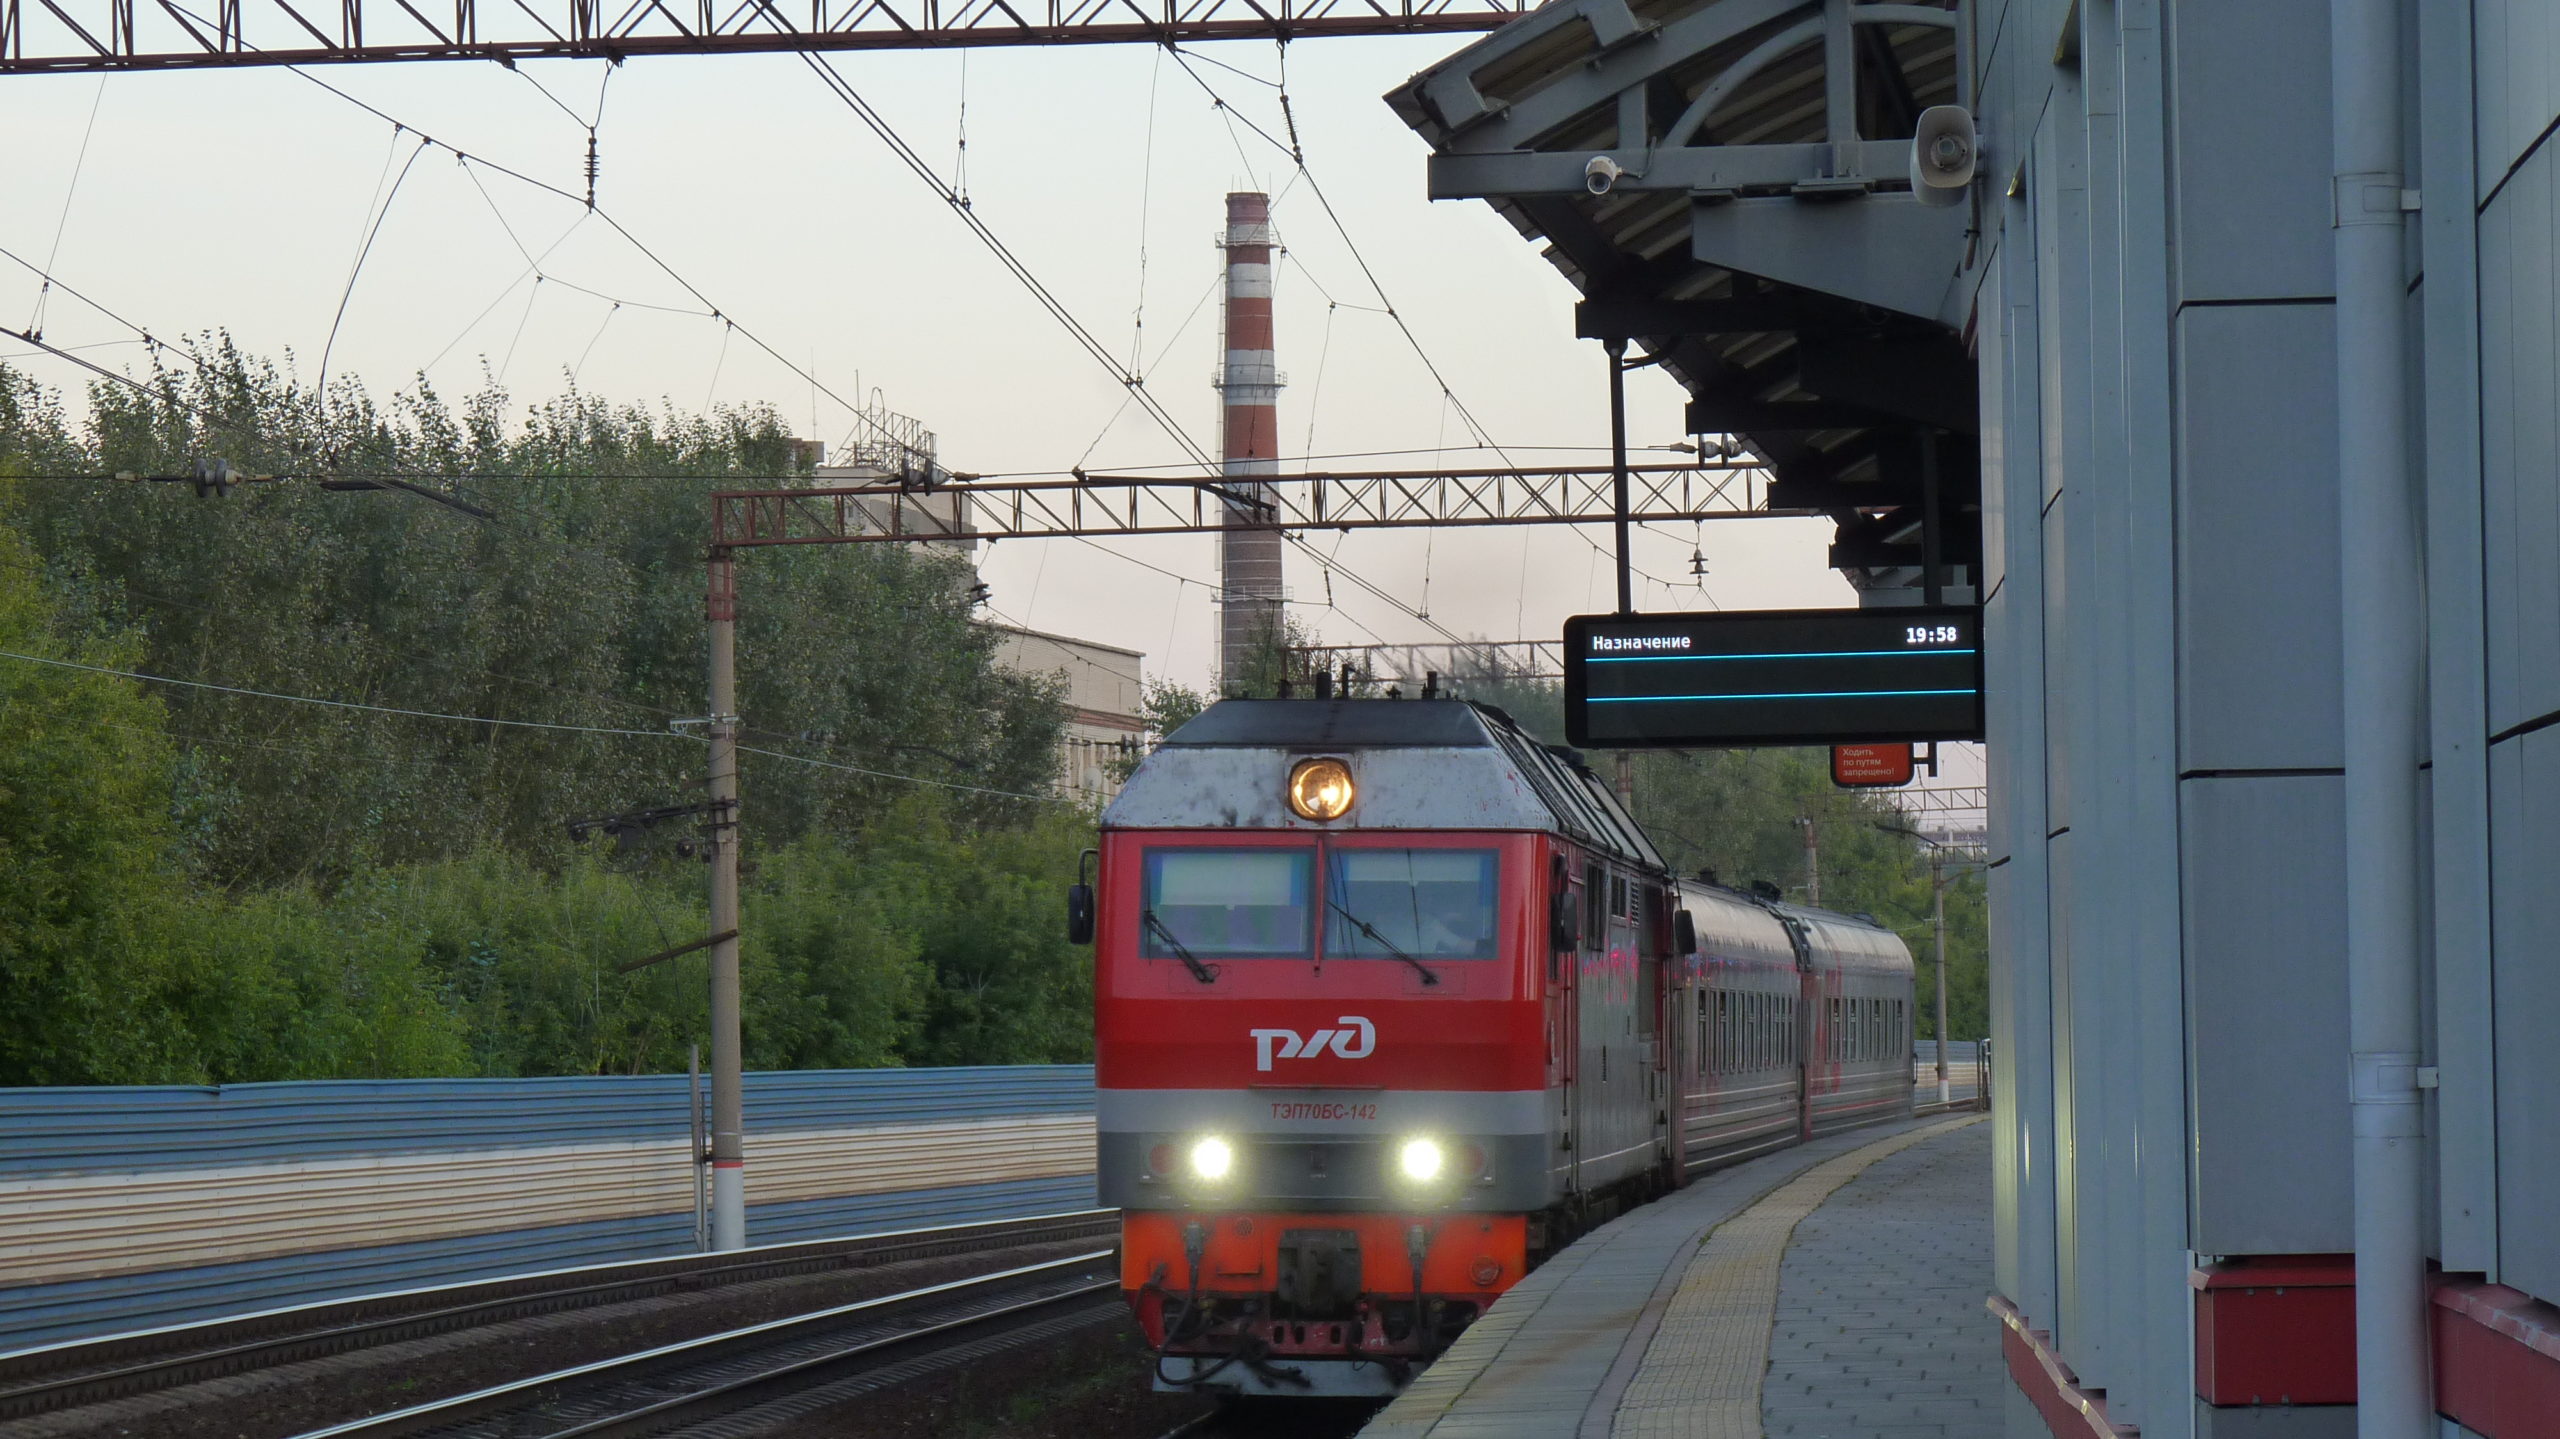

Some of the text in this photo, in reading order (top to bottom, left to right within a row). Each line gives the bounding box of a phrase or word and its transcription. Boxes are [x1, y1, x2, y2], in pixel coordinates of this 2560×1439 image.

[1905, 627, 1957, 643] 19:58
[1593, 634, 1691, 650] Назначение
[1843, 748, 1874, 757] Ходить
[1856, 759, 1881, 767] путям
[1843, 768, 1894, 777] запрещено!
[1272, 1104, 1377, 1120] ТЭП70БС-142
